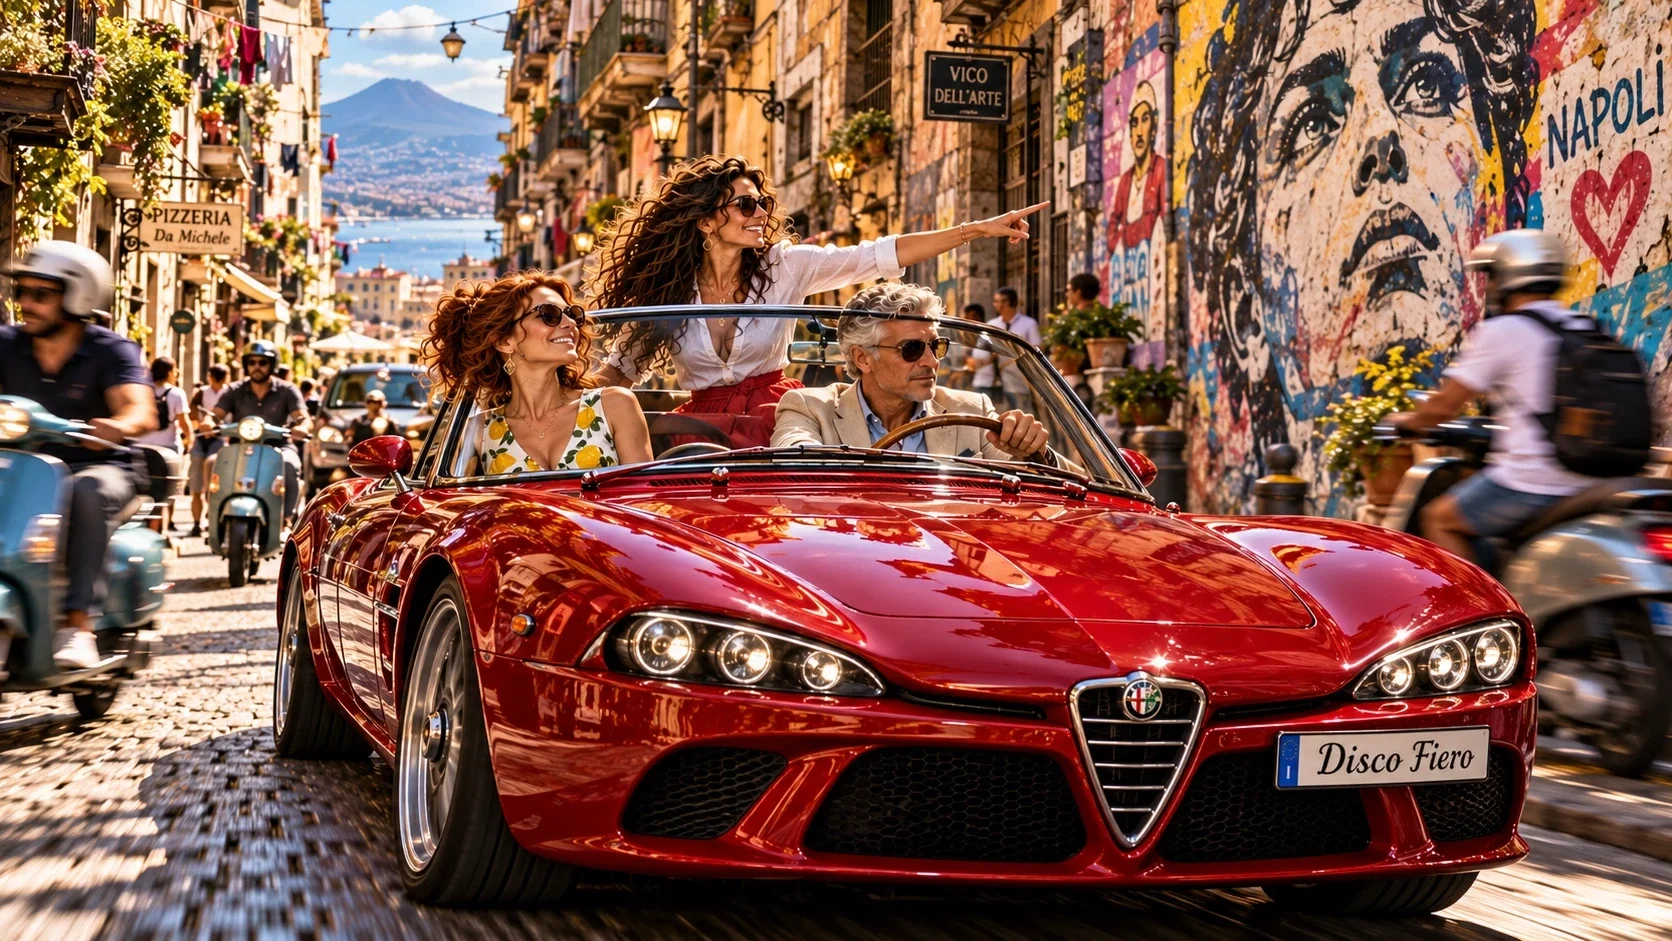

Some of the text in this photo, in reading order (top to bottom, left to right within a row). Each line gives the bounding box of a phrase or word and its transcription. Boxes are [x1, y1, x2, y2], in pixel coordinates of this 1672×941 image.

[949, 65, 988, 84] VICO
[934, 88, 1002, 107] DELL'ARTE
[152, 207, 232, 226] PIZZERIA
[154, 228, 231, 245] Da Michele
[1317, 739, 1475, 776] Disco Fiero
